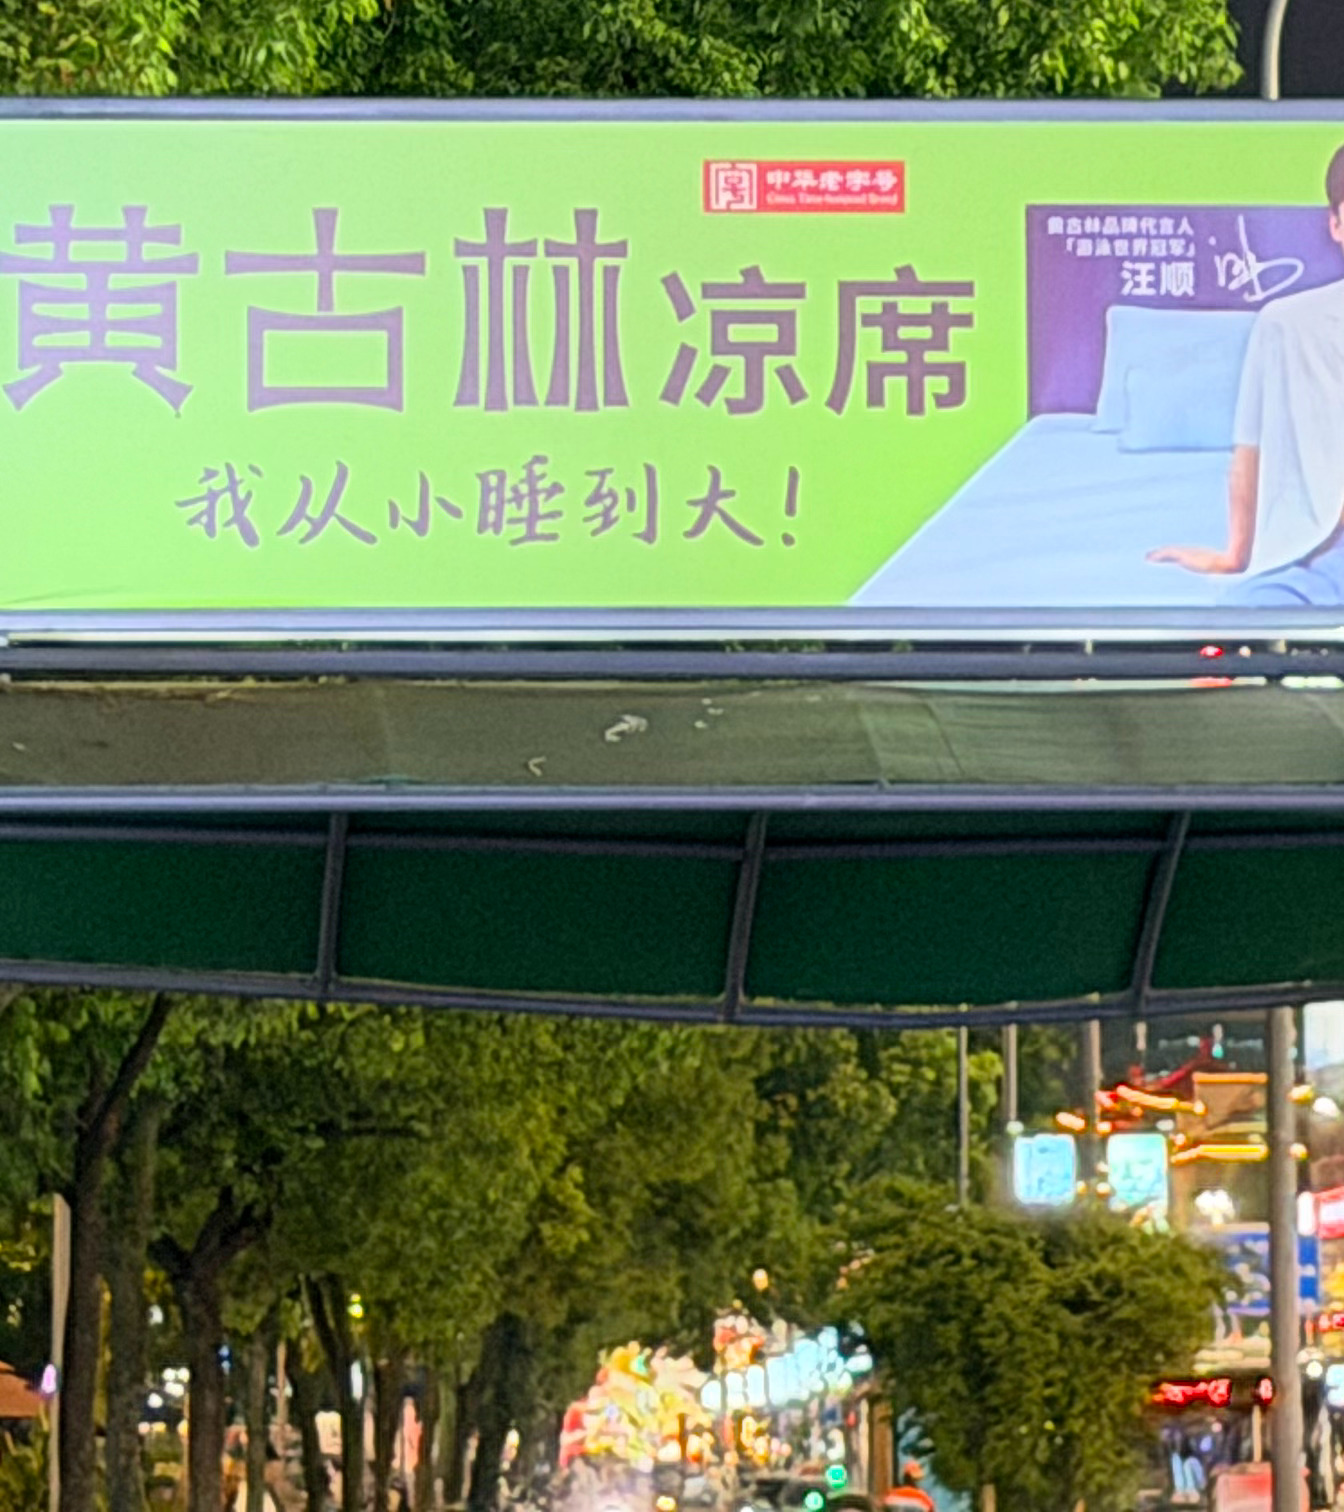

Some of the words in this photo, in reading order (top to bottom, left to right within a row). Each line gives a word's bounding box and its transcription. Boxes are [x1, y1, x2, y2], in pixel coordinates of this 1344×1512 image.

[1120, 260, 1195, 297] 汪顺
[175, 454, 799, 547] 我从小睡到大！
